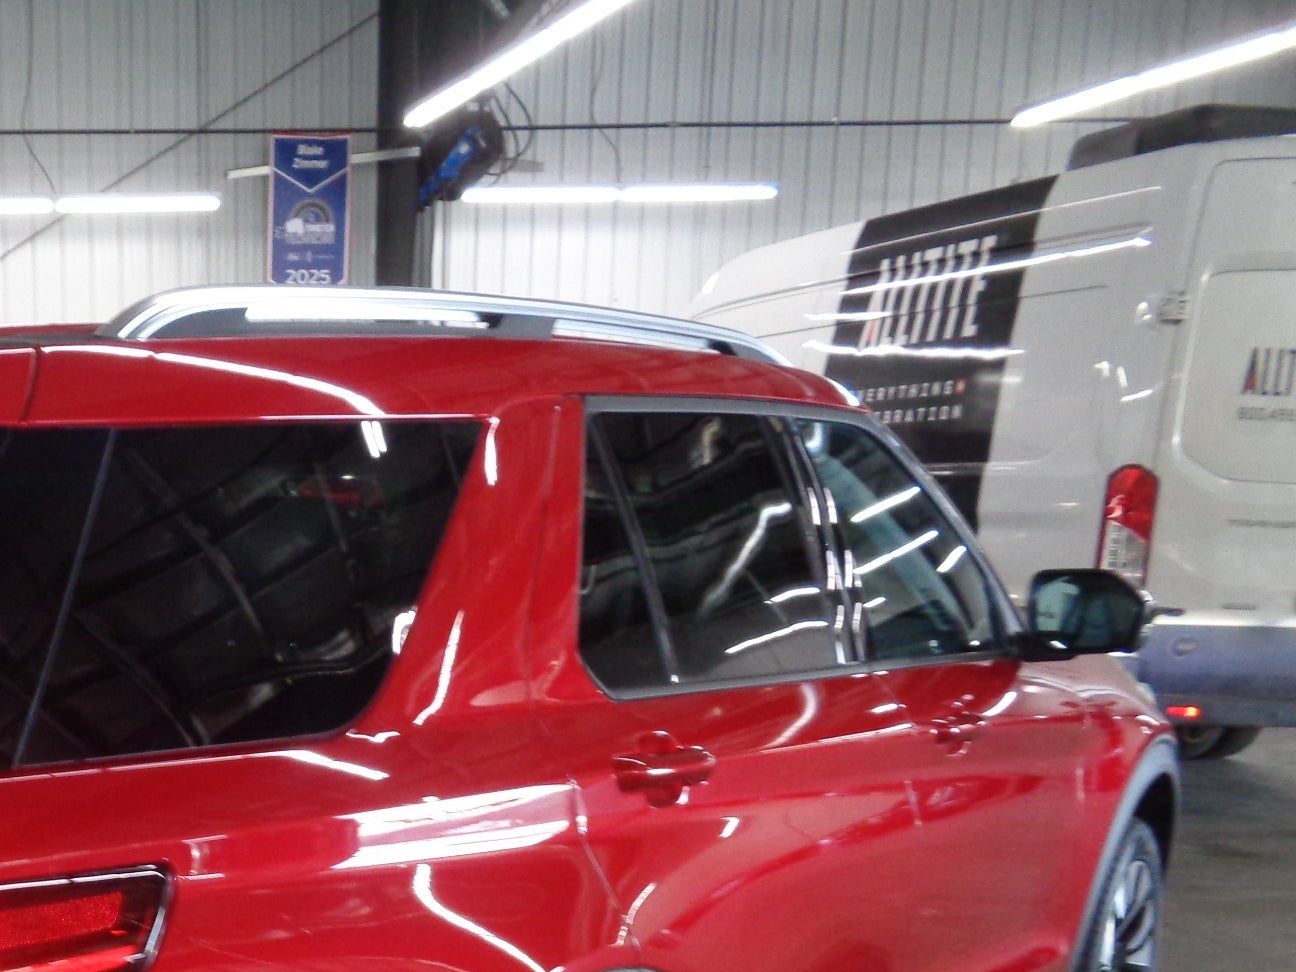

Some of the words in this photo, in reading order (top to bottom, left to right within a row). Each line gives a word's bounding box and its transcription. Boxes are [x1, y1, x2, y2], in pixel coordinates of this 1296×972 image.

[285, 269, 332, 285] 2025
[857, 234, 998, 350] ALLTITE
[857, 379, 954, 401] ERYTHING
